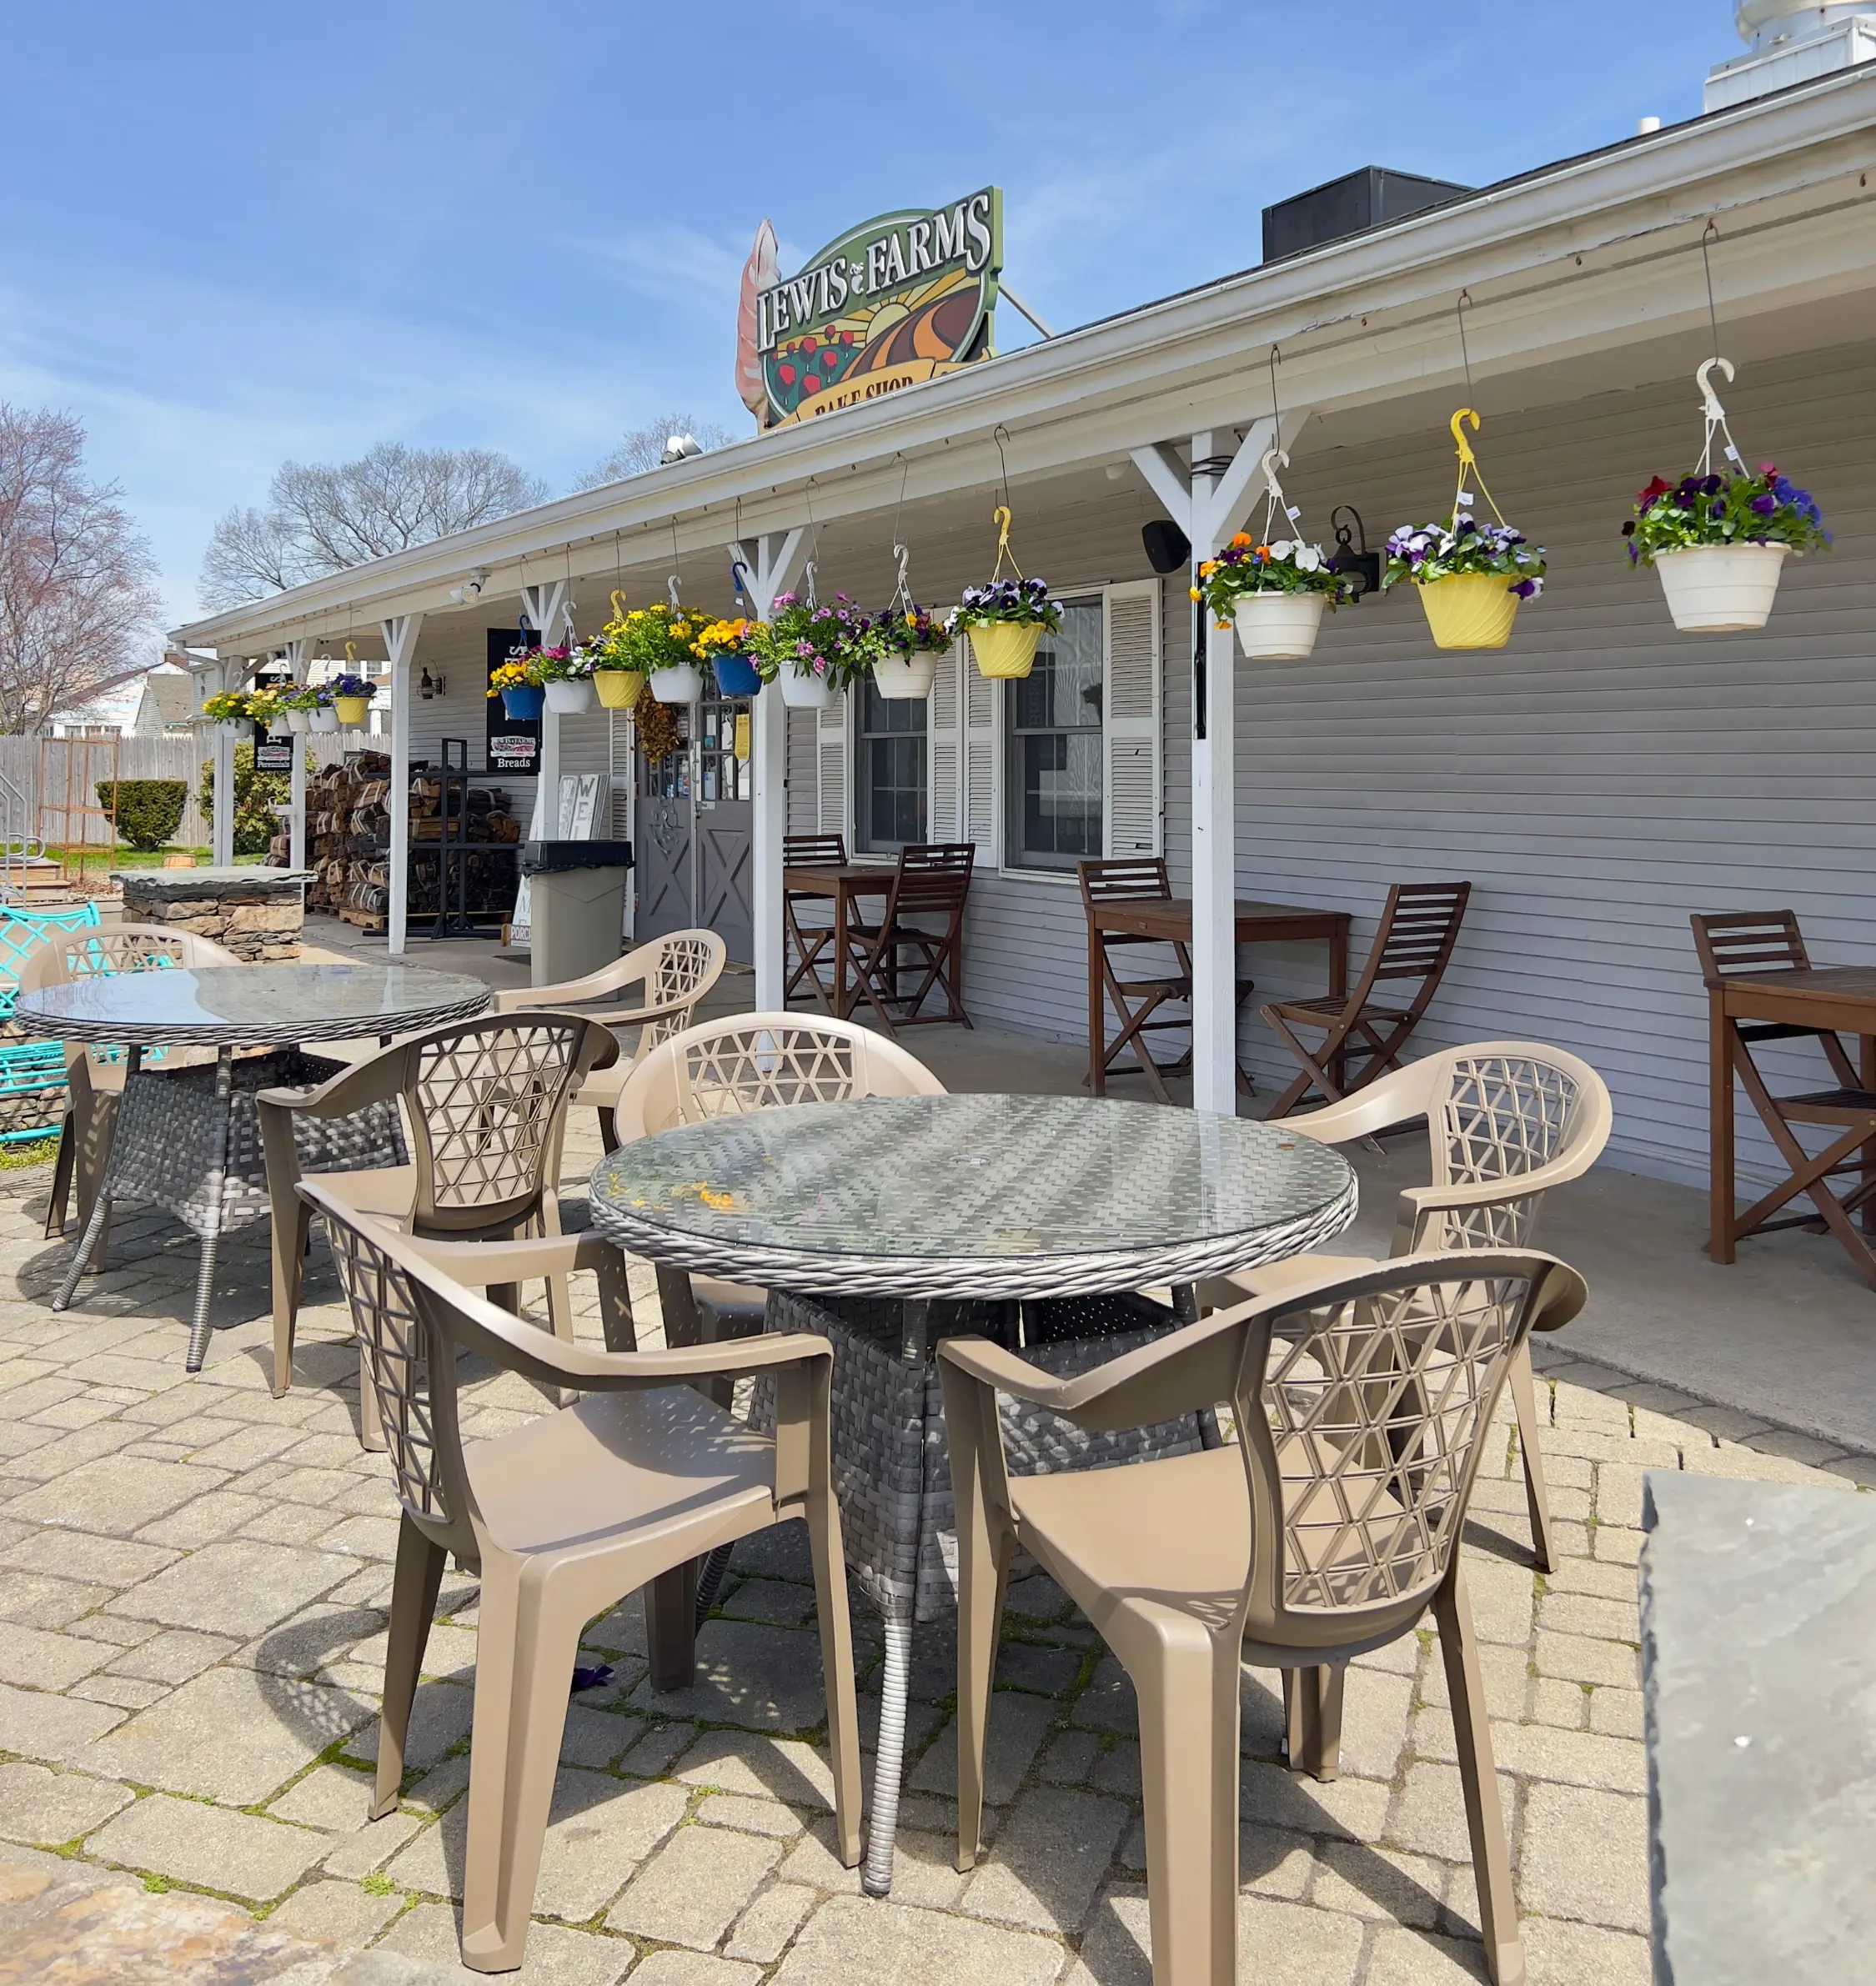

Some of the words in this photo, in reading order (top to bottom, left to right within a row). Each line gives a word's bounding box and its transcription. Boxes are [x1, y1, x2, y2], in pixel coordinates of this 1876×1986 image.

[756, 258, 848, 352] LEWIS
[865, 194, 991, 294] FARMS
[497, 758, 530, 768] Breads
